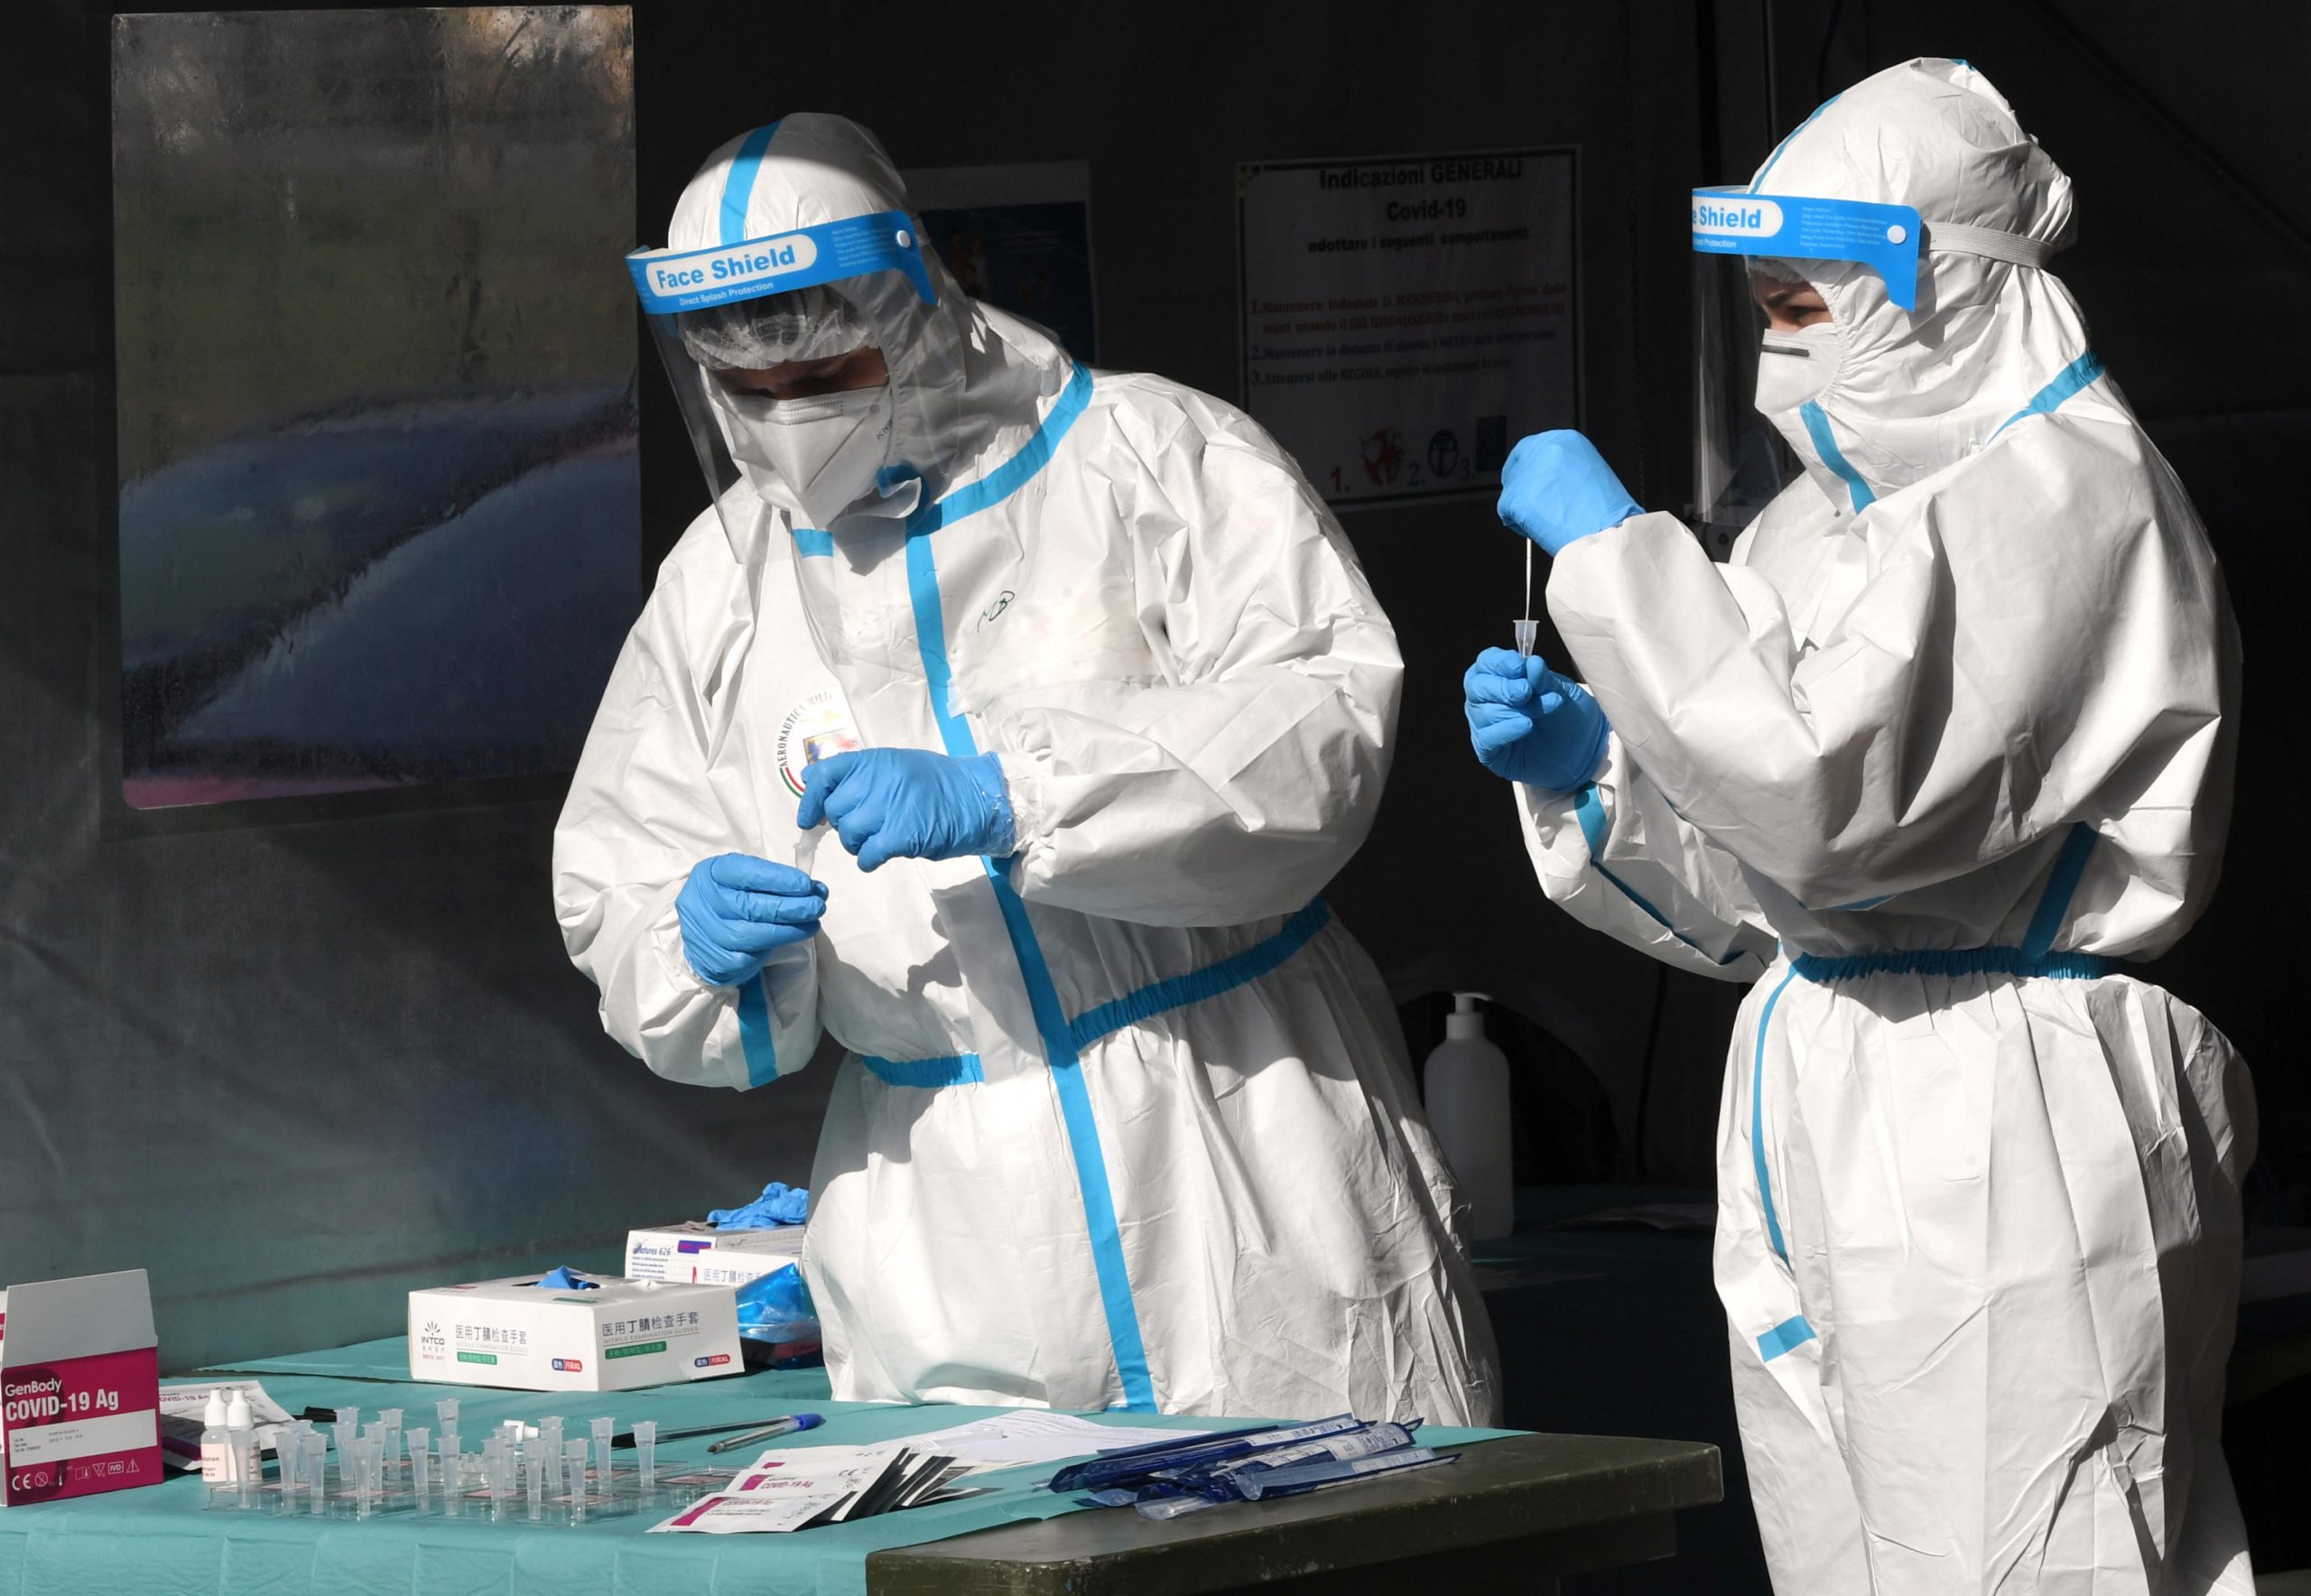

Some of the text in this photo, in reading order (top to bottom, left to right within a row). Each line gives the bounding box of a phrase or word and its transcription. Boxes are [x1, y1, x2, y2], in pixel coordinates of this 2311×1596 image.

[1320, 160, 1522, 190] Indicazioni GENERALI
[1387, 198, 1466, 222] Covid-19
[1700, 205, 1761, 229] Shield
[1308, 239, 1368, 253] adottare
[1380, 233, 1434, 250] seguenti
[656, 244, 796, 290] Face Shield
[679, 282, 774, 306] Direct Splash Protection
[1331, 466, 1350, 492] 1.
[1408, 462, 1425, 487] 2.
[1459, 458, 1476, 481] 3.
[422, 1336, 445, 1345] INTCO
[5, 1378, 62, 1396] GenBody
[5, 1388, 119, 1422] COVID-19 Ag
